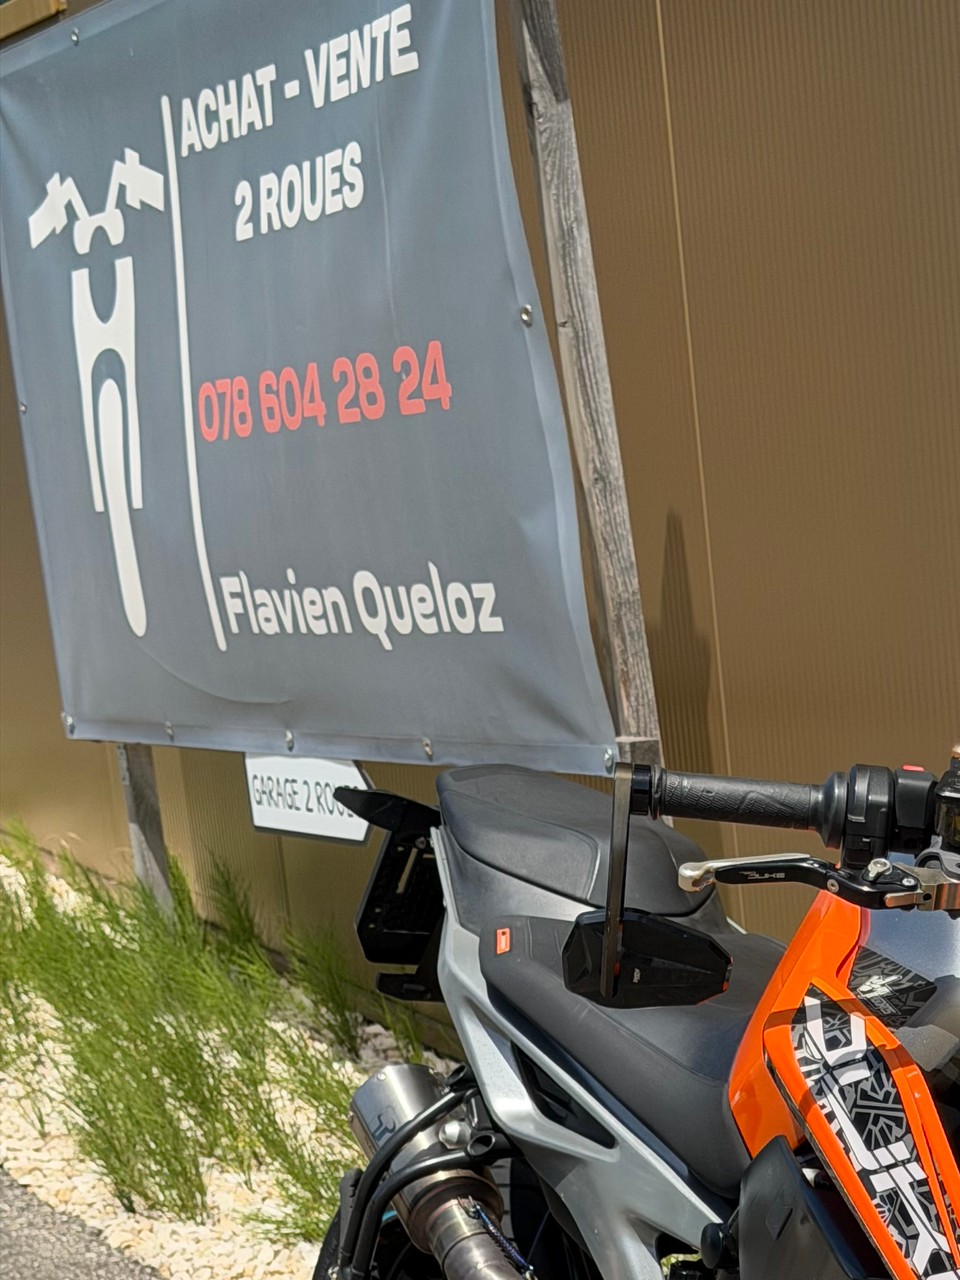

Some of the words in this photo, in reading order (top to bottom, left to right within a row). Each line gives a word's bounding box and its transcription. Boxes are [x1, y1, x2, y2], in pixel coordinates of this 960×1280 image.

[181, 65, 277, 157] ACHAT
[304, 4, 419, 109] VENTE
[234, 180, 254, 242] 2
[259, 141, 364, 234] ROUES
[199, 377, 252, 441] 078
[258, 363, 325, 433] 604
[332, 353, 385, 423] 28
[392, 341, 452, 415] 24
[220, 569, 353, 635] Flavien
[353, 561, 504, 651] Queloz
[252, 774, 301, 811] GARAGE
[303, 780, 314, 813] 2
